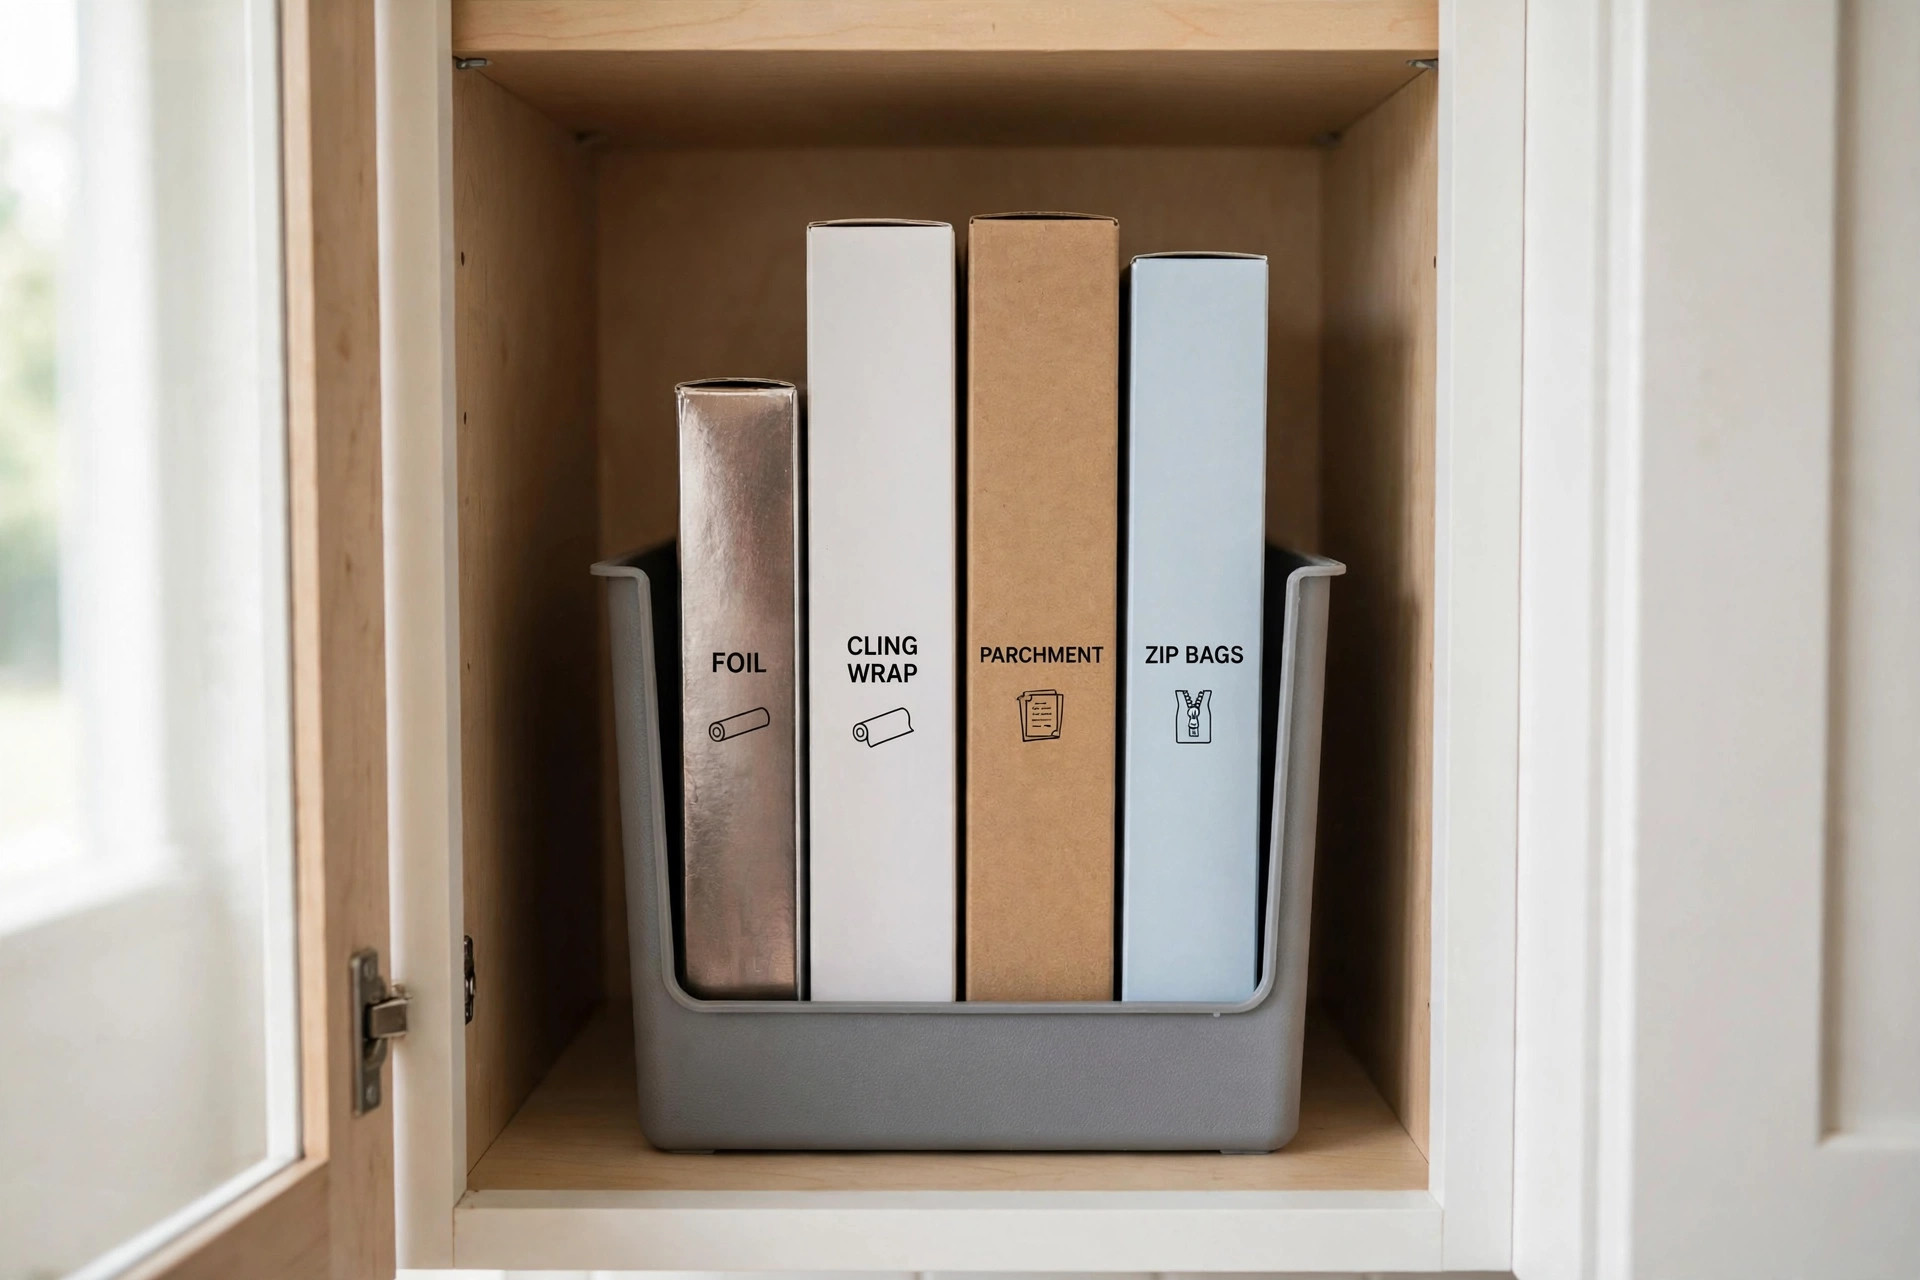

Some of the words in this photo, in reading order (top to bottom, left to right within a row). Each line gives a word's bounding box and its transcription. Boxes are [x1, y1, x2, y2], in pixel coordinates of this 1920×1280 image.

[847, 635, 918, 656] CLING
[980, 646, 1104, 664] PARCHMENT
[1145, 645, 1179, 664] ZIP
[1185, 645, 1244, 664] BAGS
[712, 652, 767, 674] FOIL
[847, 663, 918, 684] WRAP
